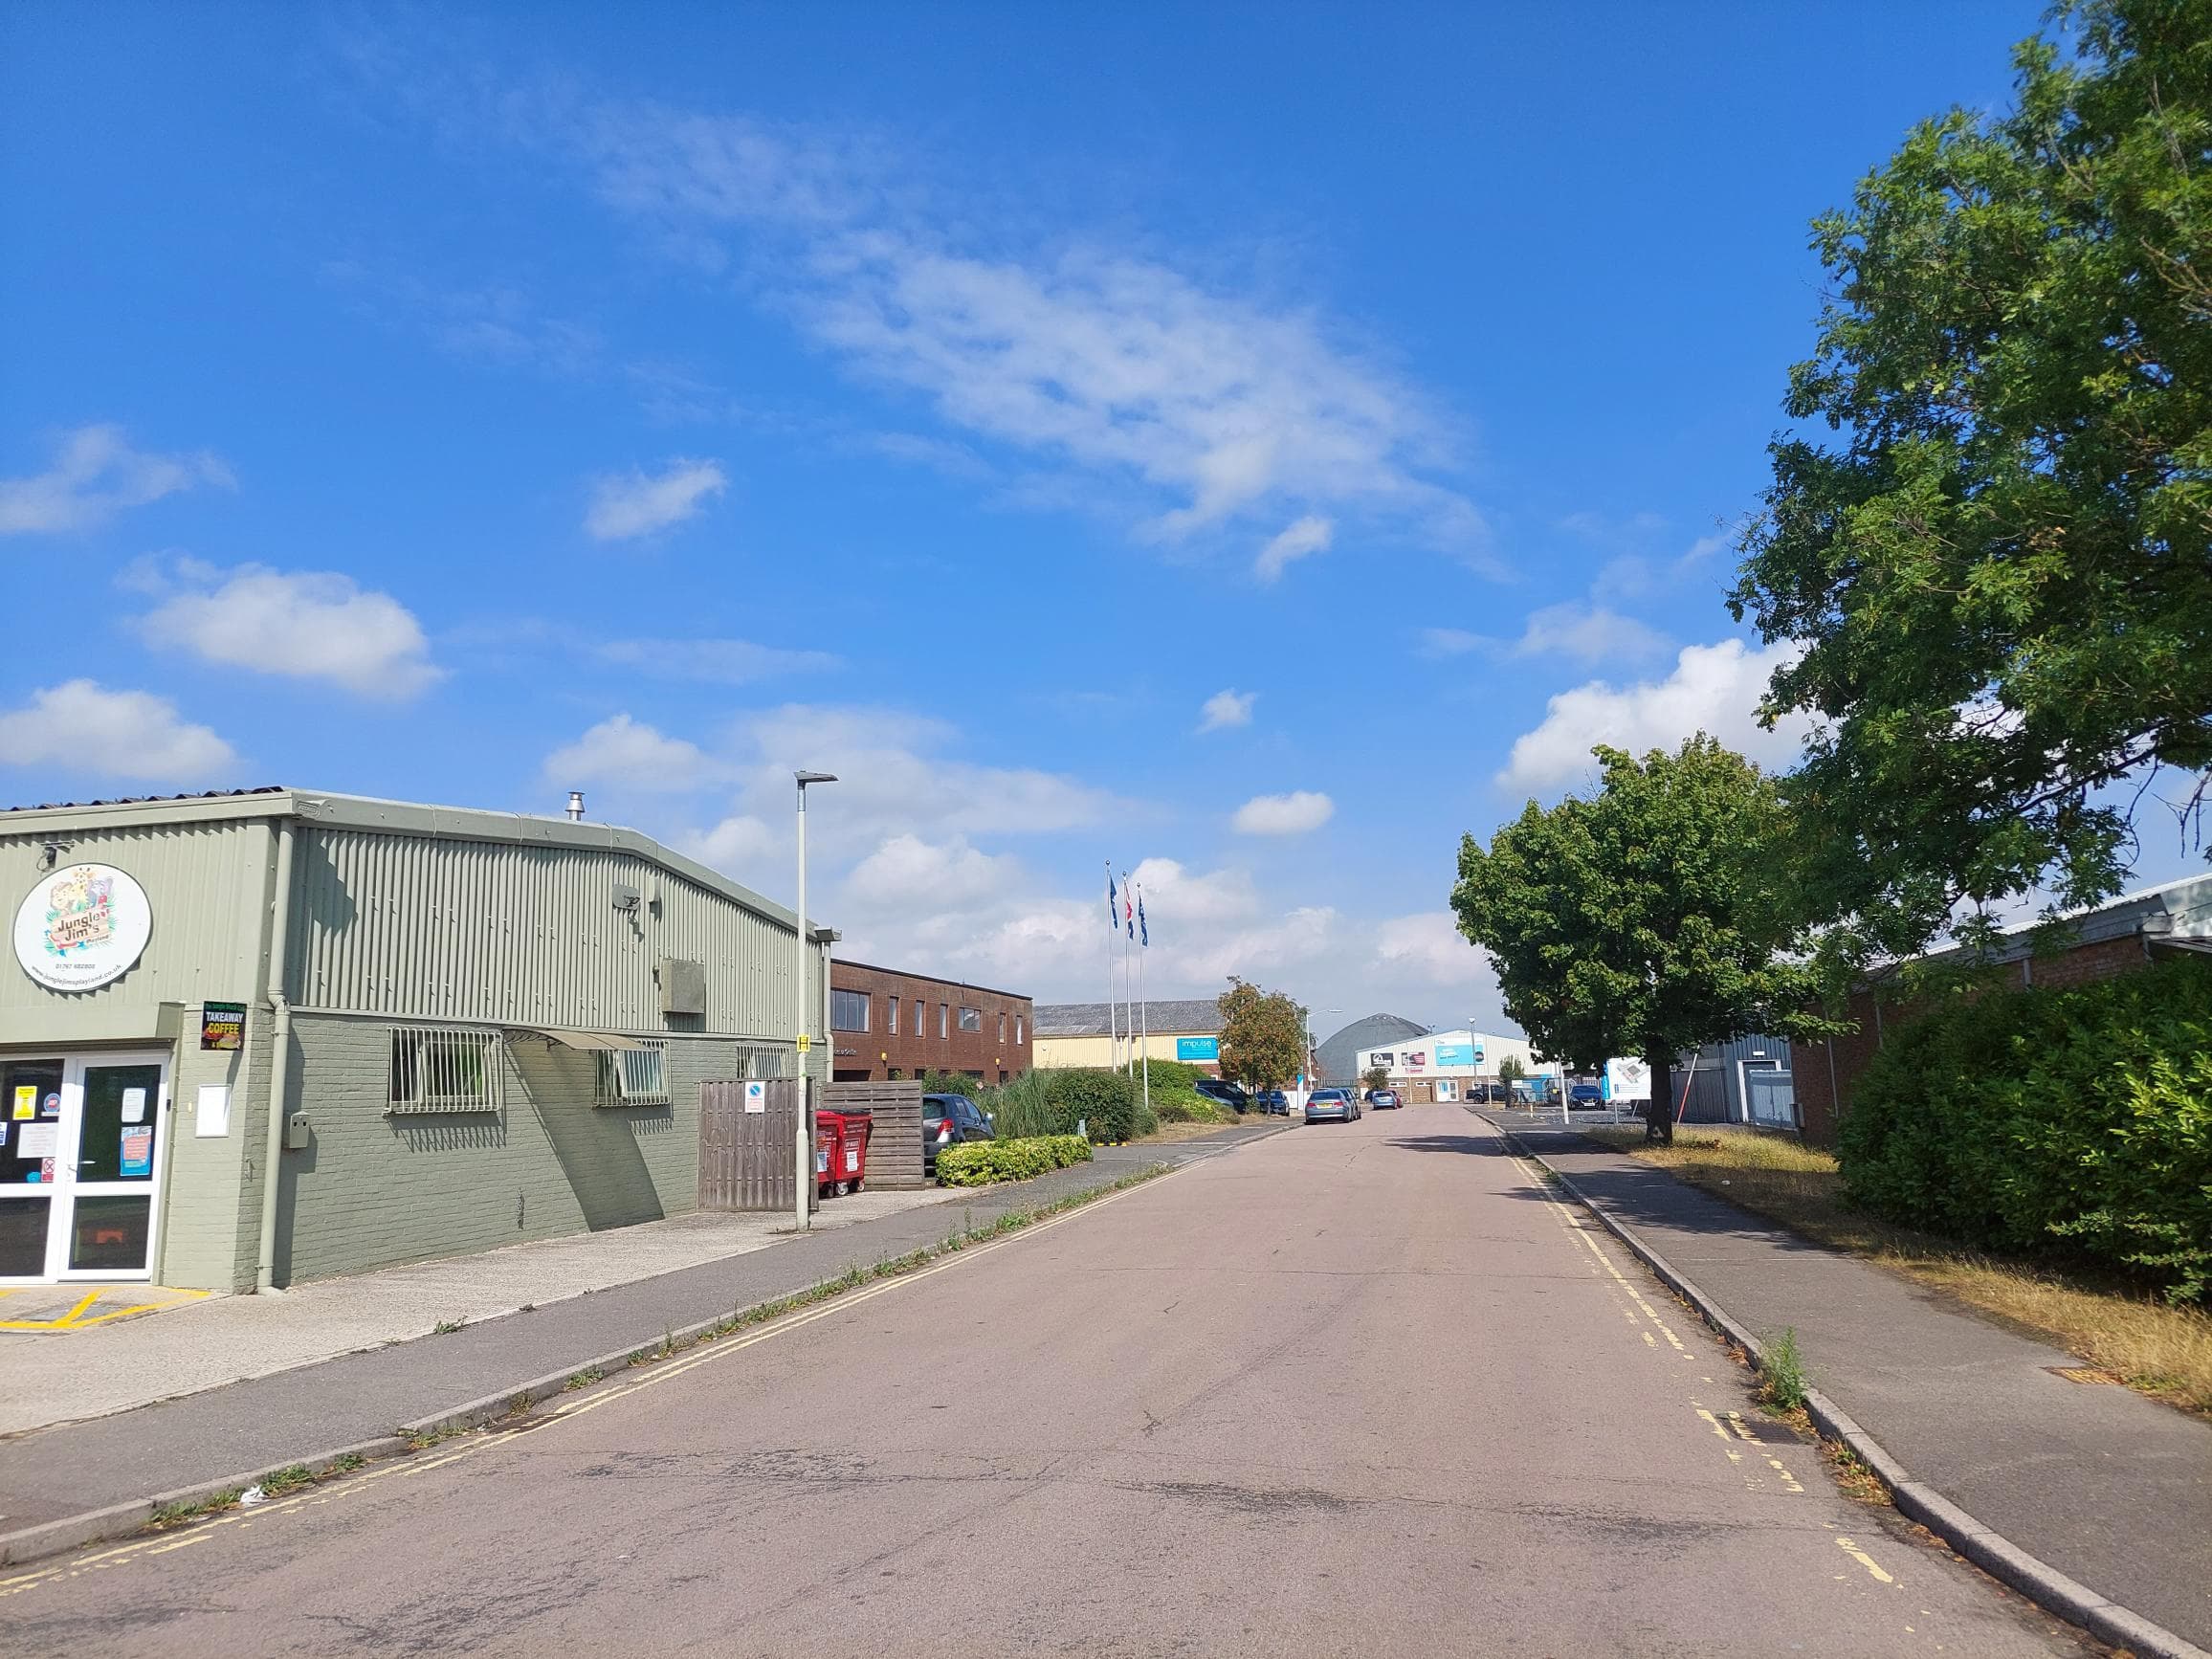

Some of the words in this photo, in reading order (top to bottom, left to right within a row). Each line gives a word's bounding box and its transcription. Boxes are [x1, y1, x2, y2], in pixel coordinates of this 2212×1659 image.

[57, 912, 100, 932] Jungle
[65, 924, 100, 941] Jim's
[206, 1011, 244, 1023] TAKEAWAY
[209, 1023, 240, 1034] COFFEE
[799, 1036, 808, 1051] H
[1182, 1039, 1212, 1049] impulse
